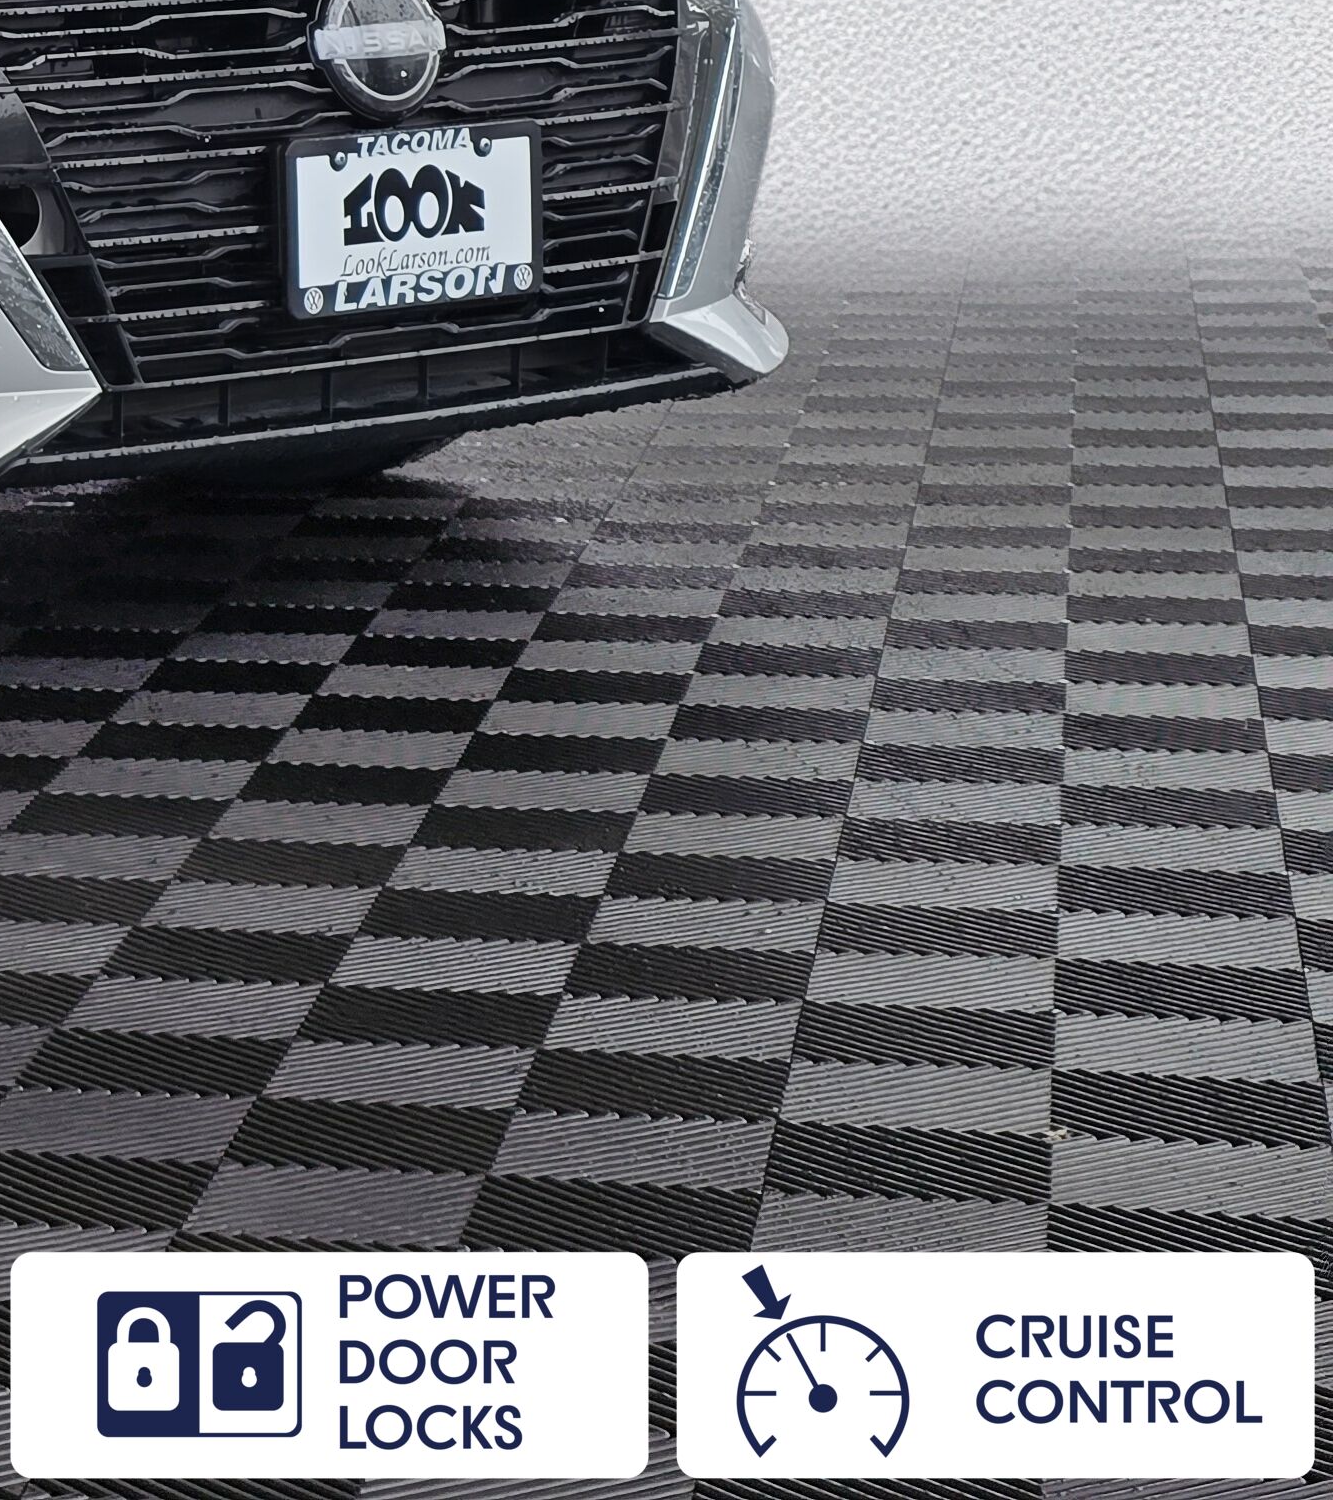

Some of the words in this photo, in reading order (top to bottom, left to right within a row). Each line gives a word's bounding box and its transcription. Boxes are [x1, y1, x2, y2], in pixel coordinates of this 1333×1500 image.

[356, 127, 473, 158] TACOMA
[342, 163, 486, 247] LOOK
[339, 244, 492, 278] LookLarson.com
[333, 263, 507, 313] LARSON
